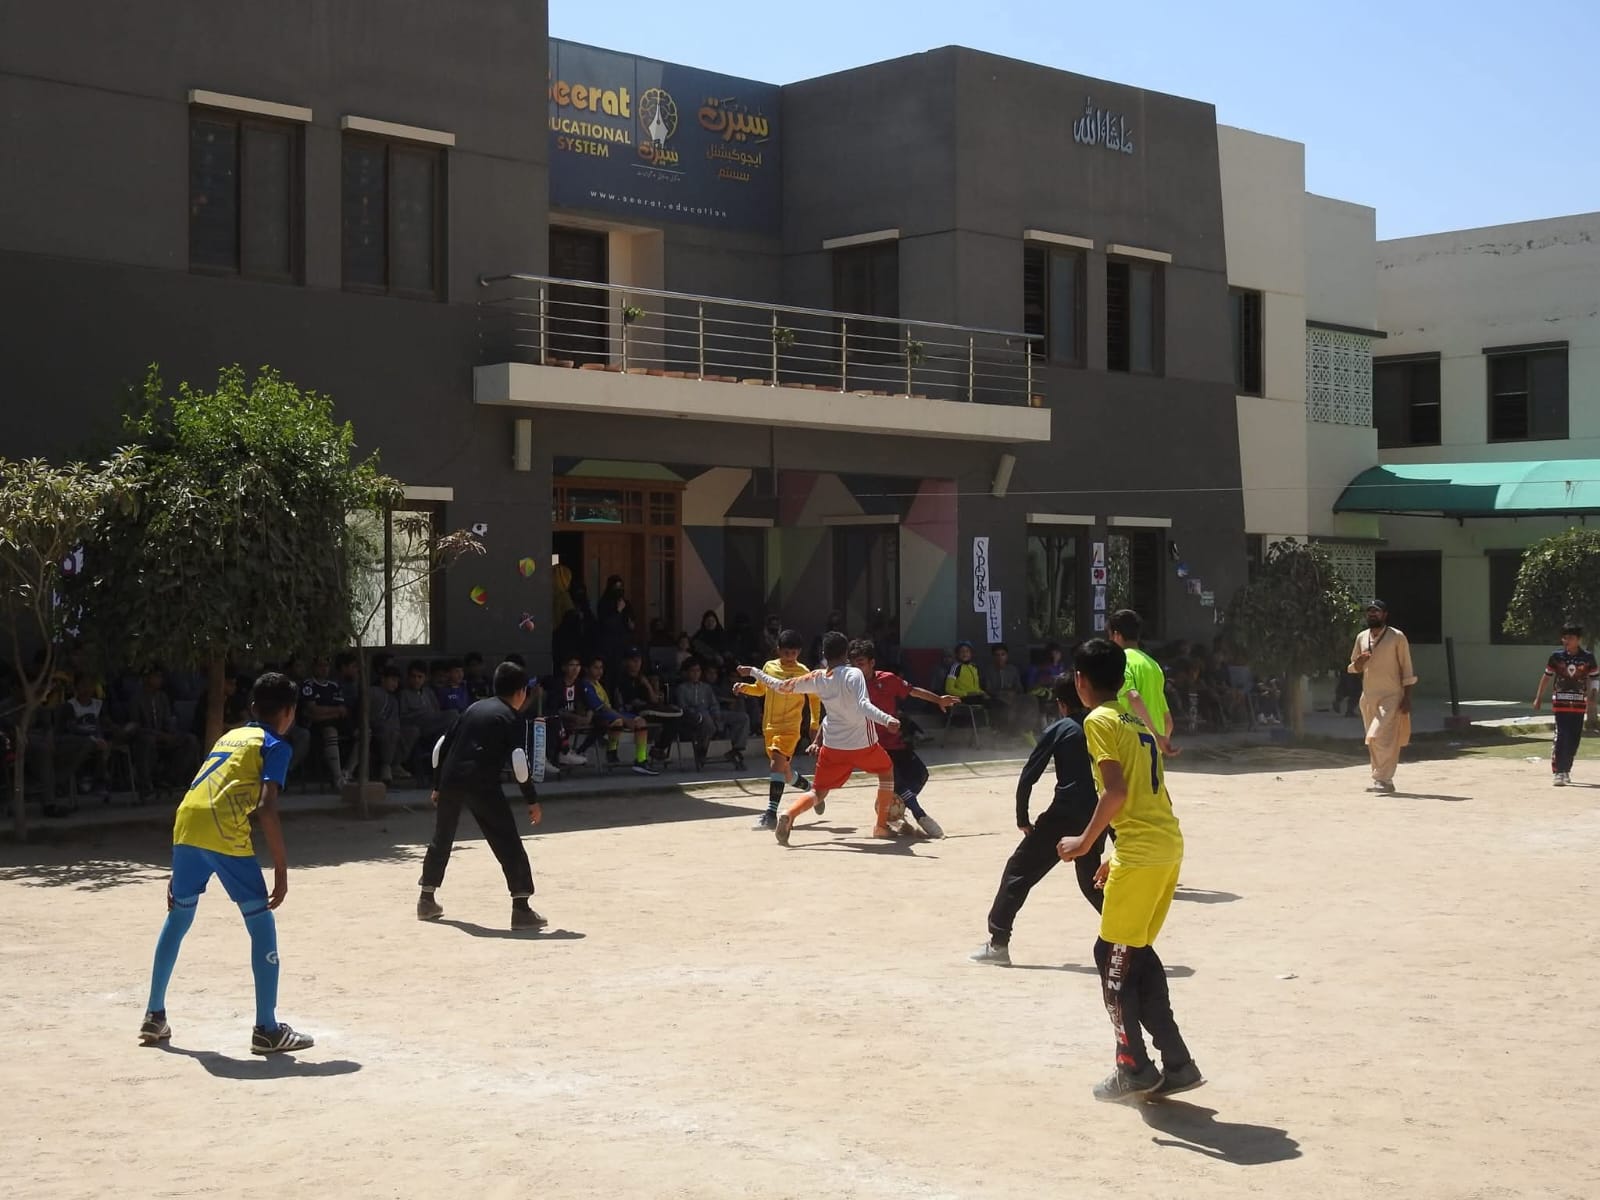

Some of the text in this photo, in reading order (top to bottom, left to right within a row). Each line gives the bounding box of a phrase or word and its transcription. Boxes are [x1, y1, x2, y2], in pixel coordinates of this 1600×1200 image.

[549, 80, 630, 118] eerat
[549, 117, 631, 144] UCATIONAL
[557, 136, 609, 157] SYSTEM
[191, 751, 233, 790] 7
[1137, 732, 1159, 795] 7
